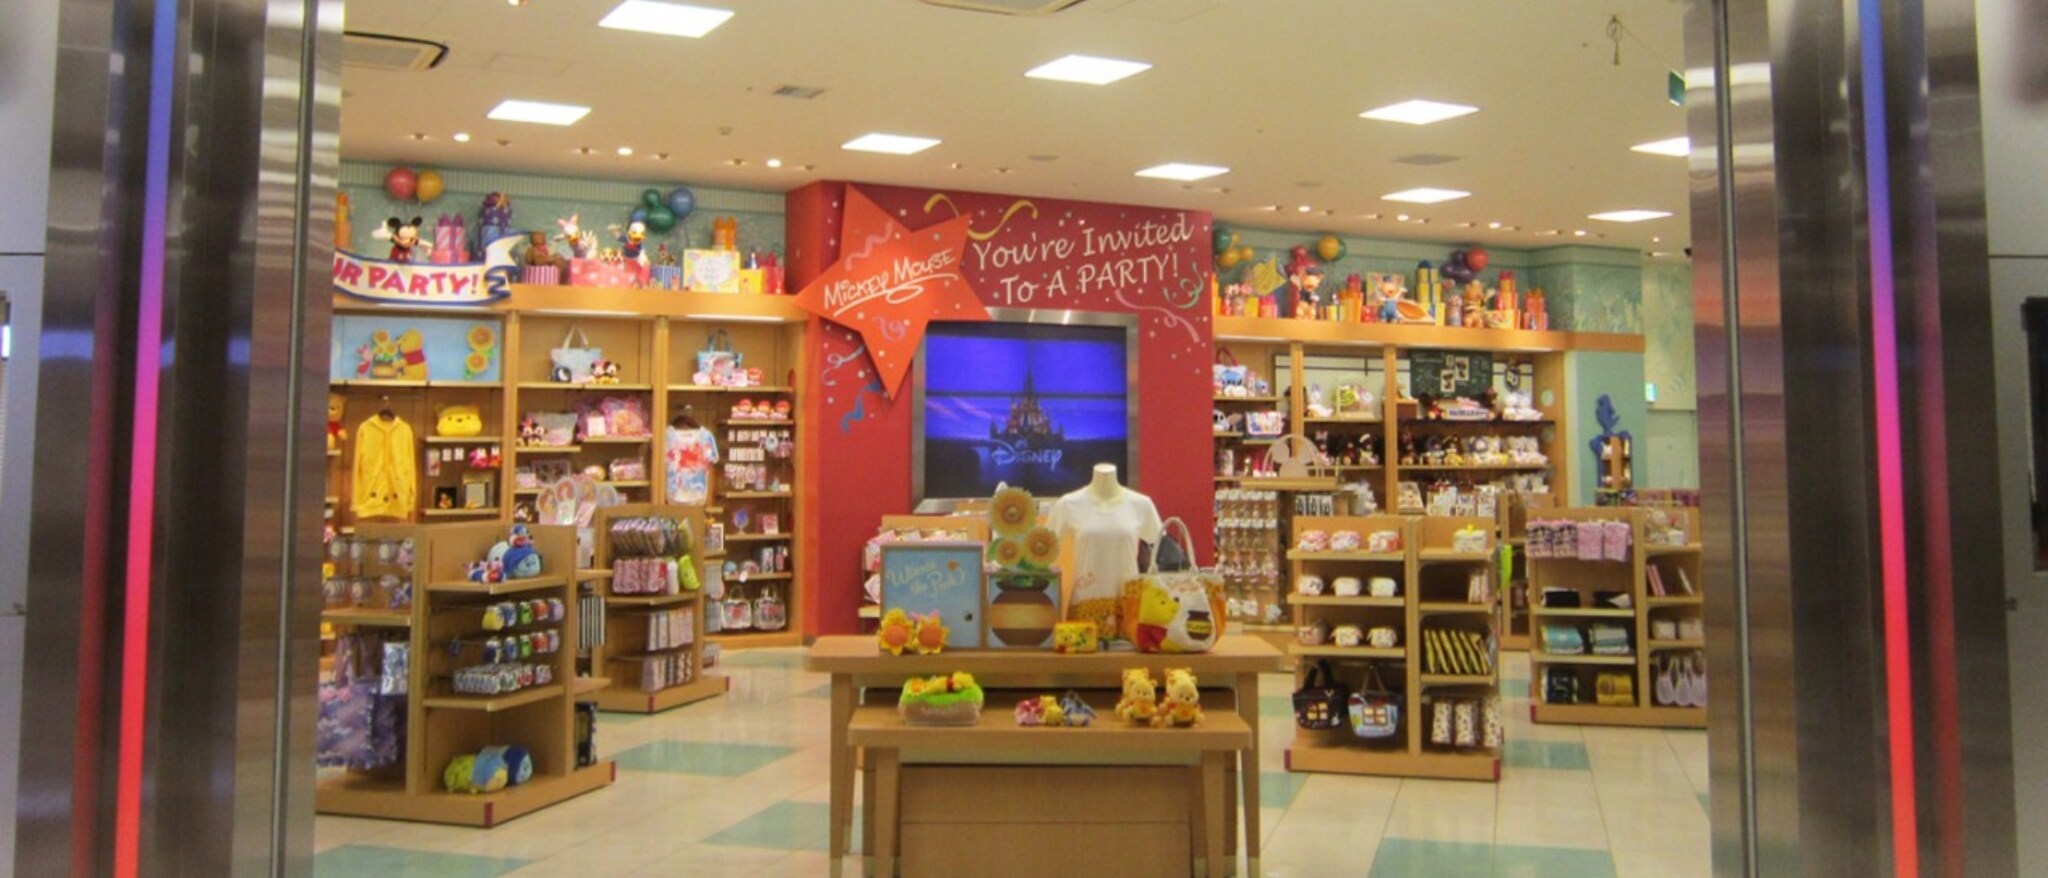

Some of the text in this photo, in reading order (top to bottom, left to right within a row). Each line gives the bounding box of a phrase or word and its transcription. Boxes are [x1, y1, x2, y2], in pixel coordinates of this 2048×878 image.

[972, 212, 1195, 271] You're Invited
[368, 265, 479, 296] PARTY!
[1000, 252, 1180, 305] To A PARTY!
